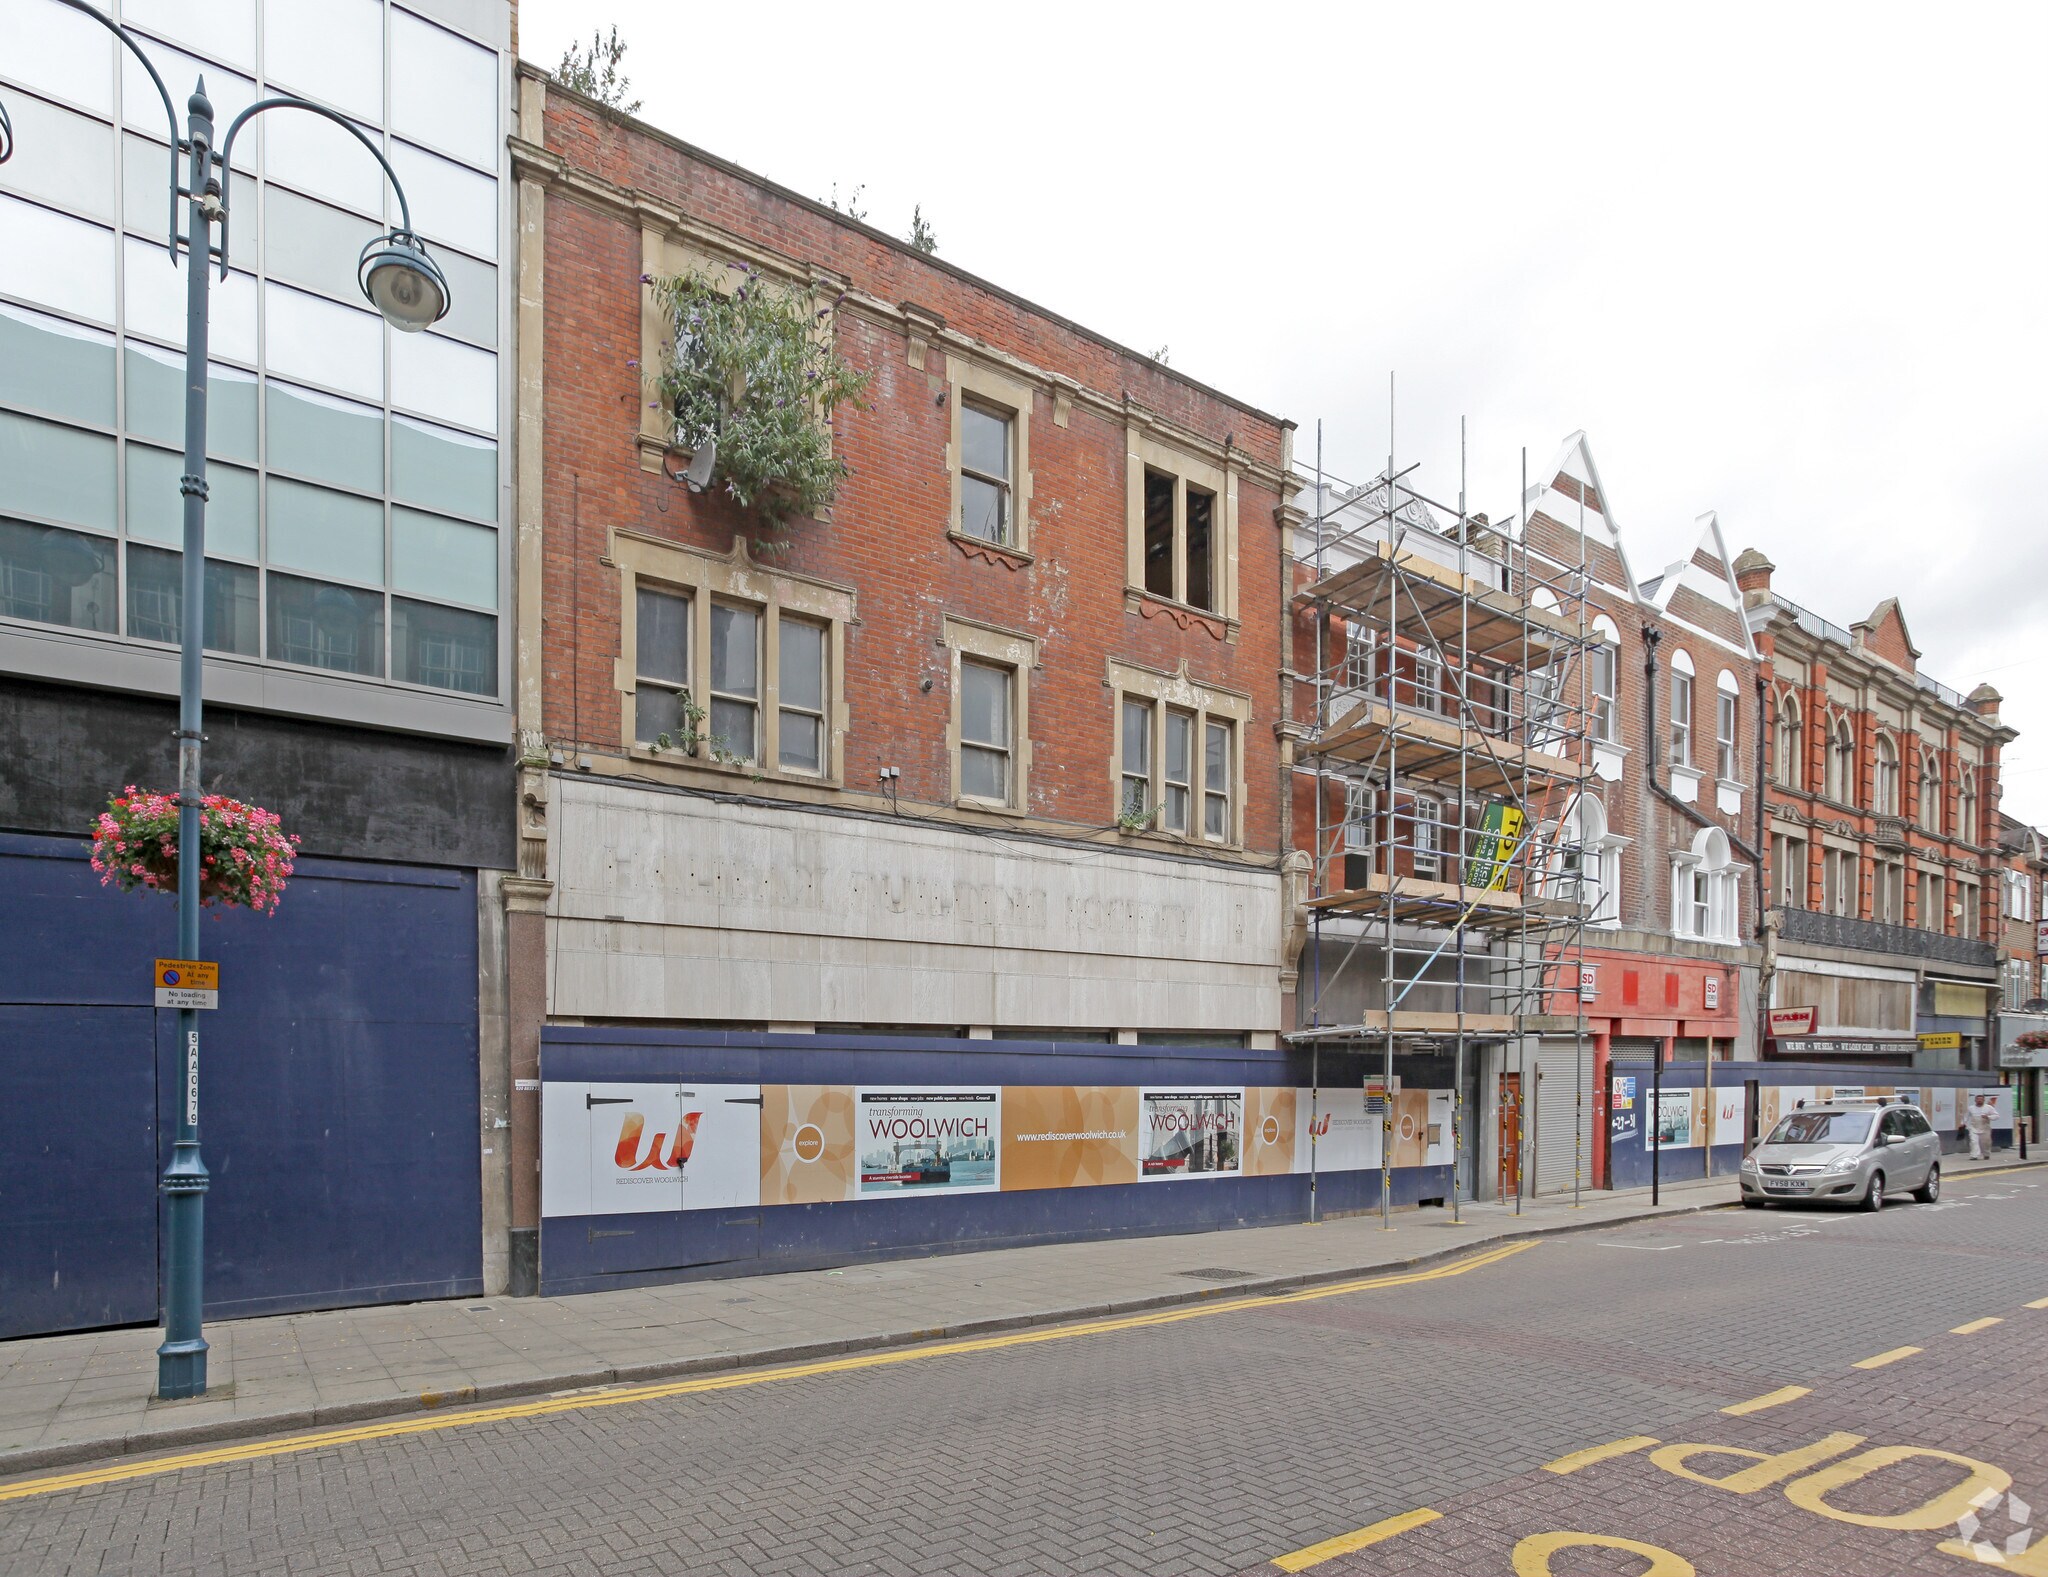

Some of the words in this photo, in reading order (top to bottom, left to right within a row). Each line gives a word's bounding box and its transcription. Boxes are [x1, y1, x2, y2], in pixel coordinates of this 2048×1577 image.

[1503, 816, 1521, 851] TO
[159, 962, 197, 970] Pedestrian
[1582, 973, 1594, 985] SD
[1707, 983, 1717, 994] SD
[181, 991, 206, 999] loading
[869, 1106, 924, 1118] transforming
[1149, 1113, 1235, 1131] WOOLWICH
[869, 1118, 988, 1140] WOOLWICH
[1016, 1129, 1127, 1142] www.rediscoverwoolwich.co.uk
[615, 1177, 654, 1185] REDISCOVER
[654, 1176, 689, 1184] WOOLWICH
